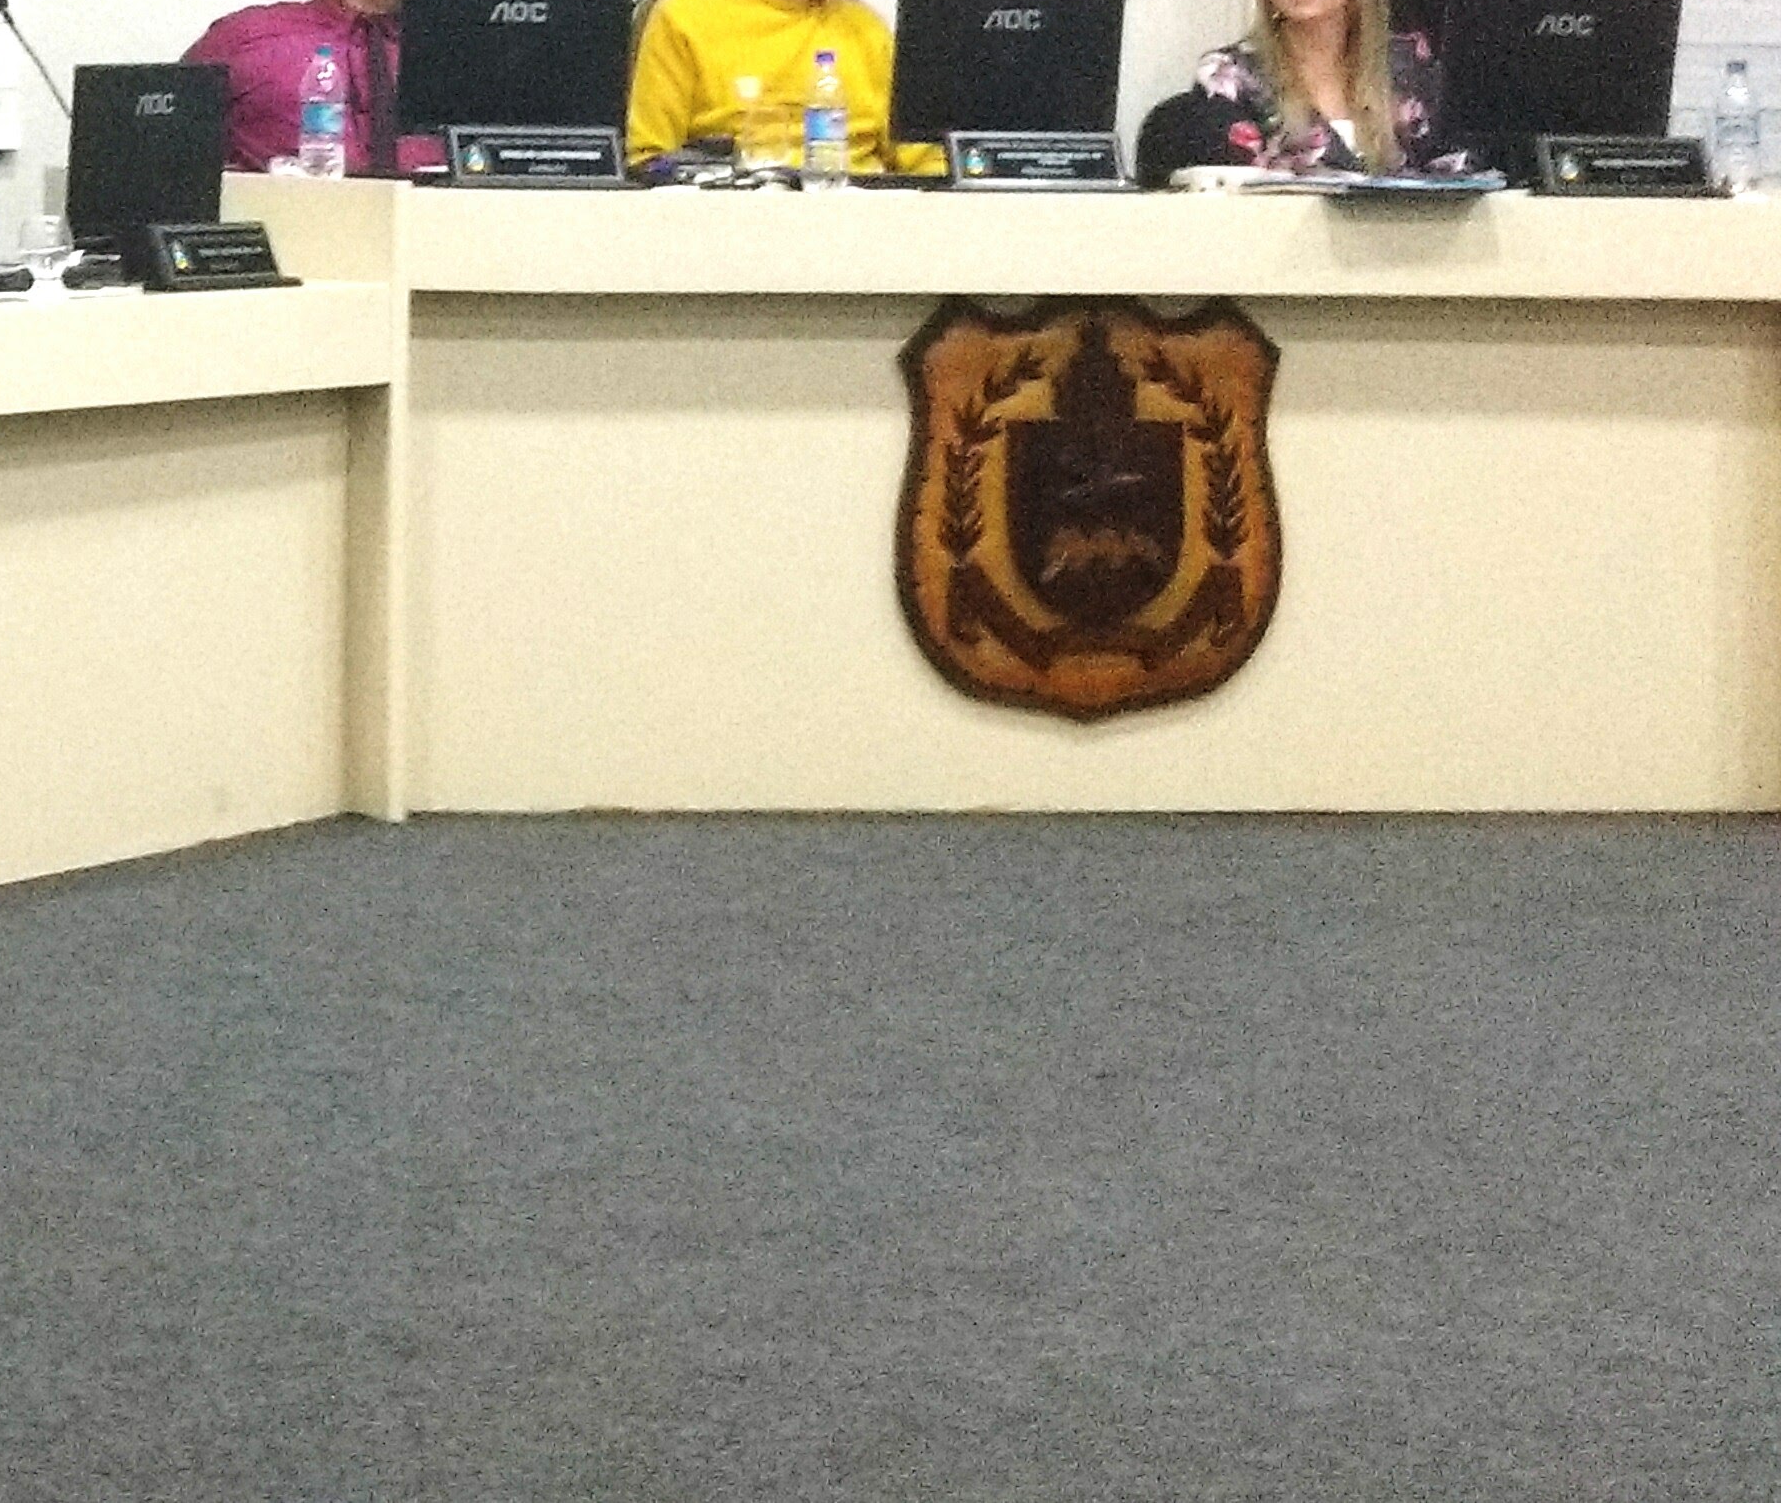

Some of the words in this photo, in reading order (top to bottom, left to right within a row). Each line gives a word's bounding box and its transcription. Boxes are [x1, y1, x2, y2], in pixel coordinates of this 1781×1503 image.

[489, 0, 548, 23] AOC
[983, 8, 1043, 30] AOC
[1536, 13, 1596, 36] AOC
